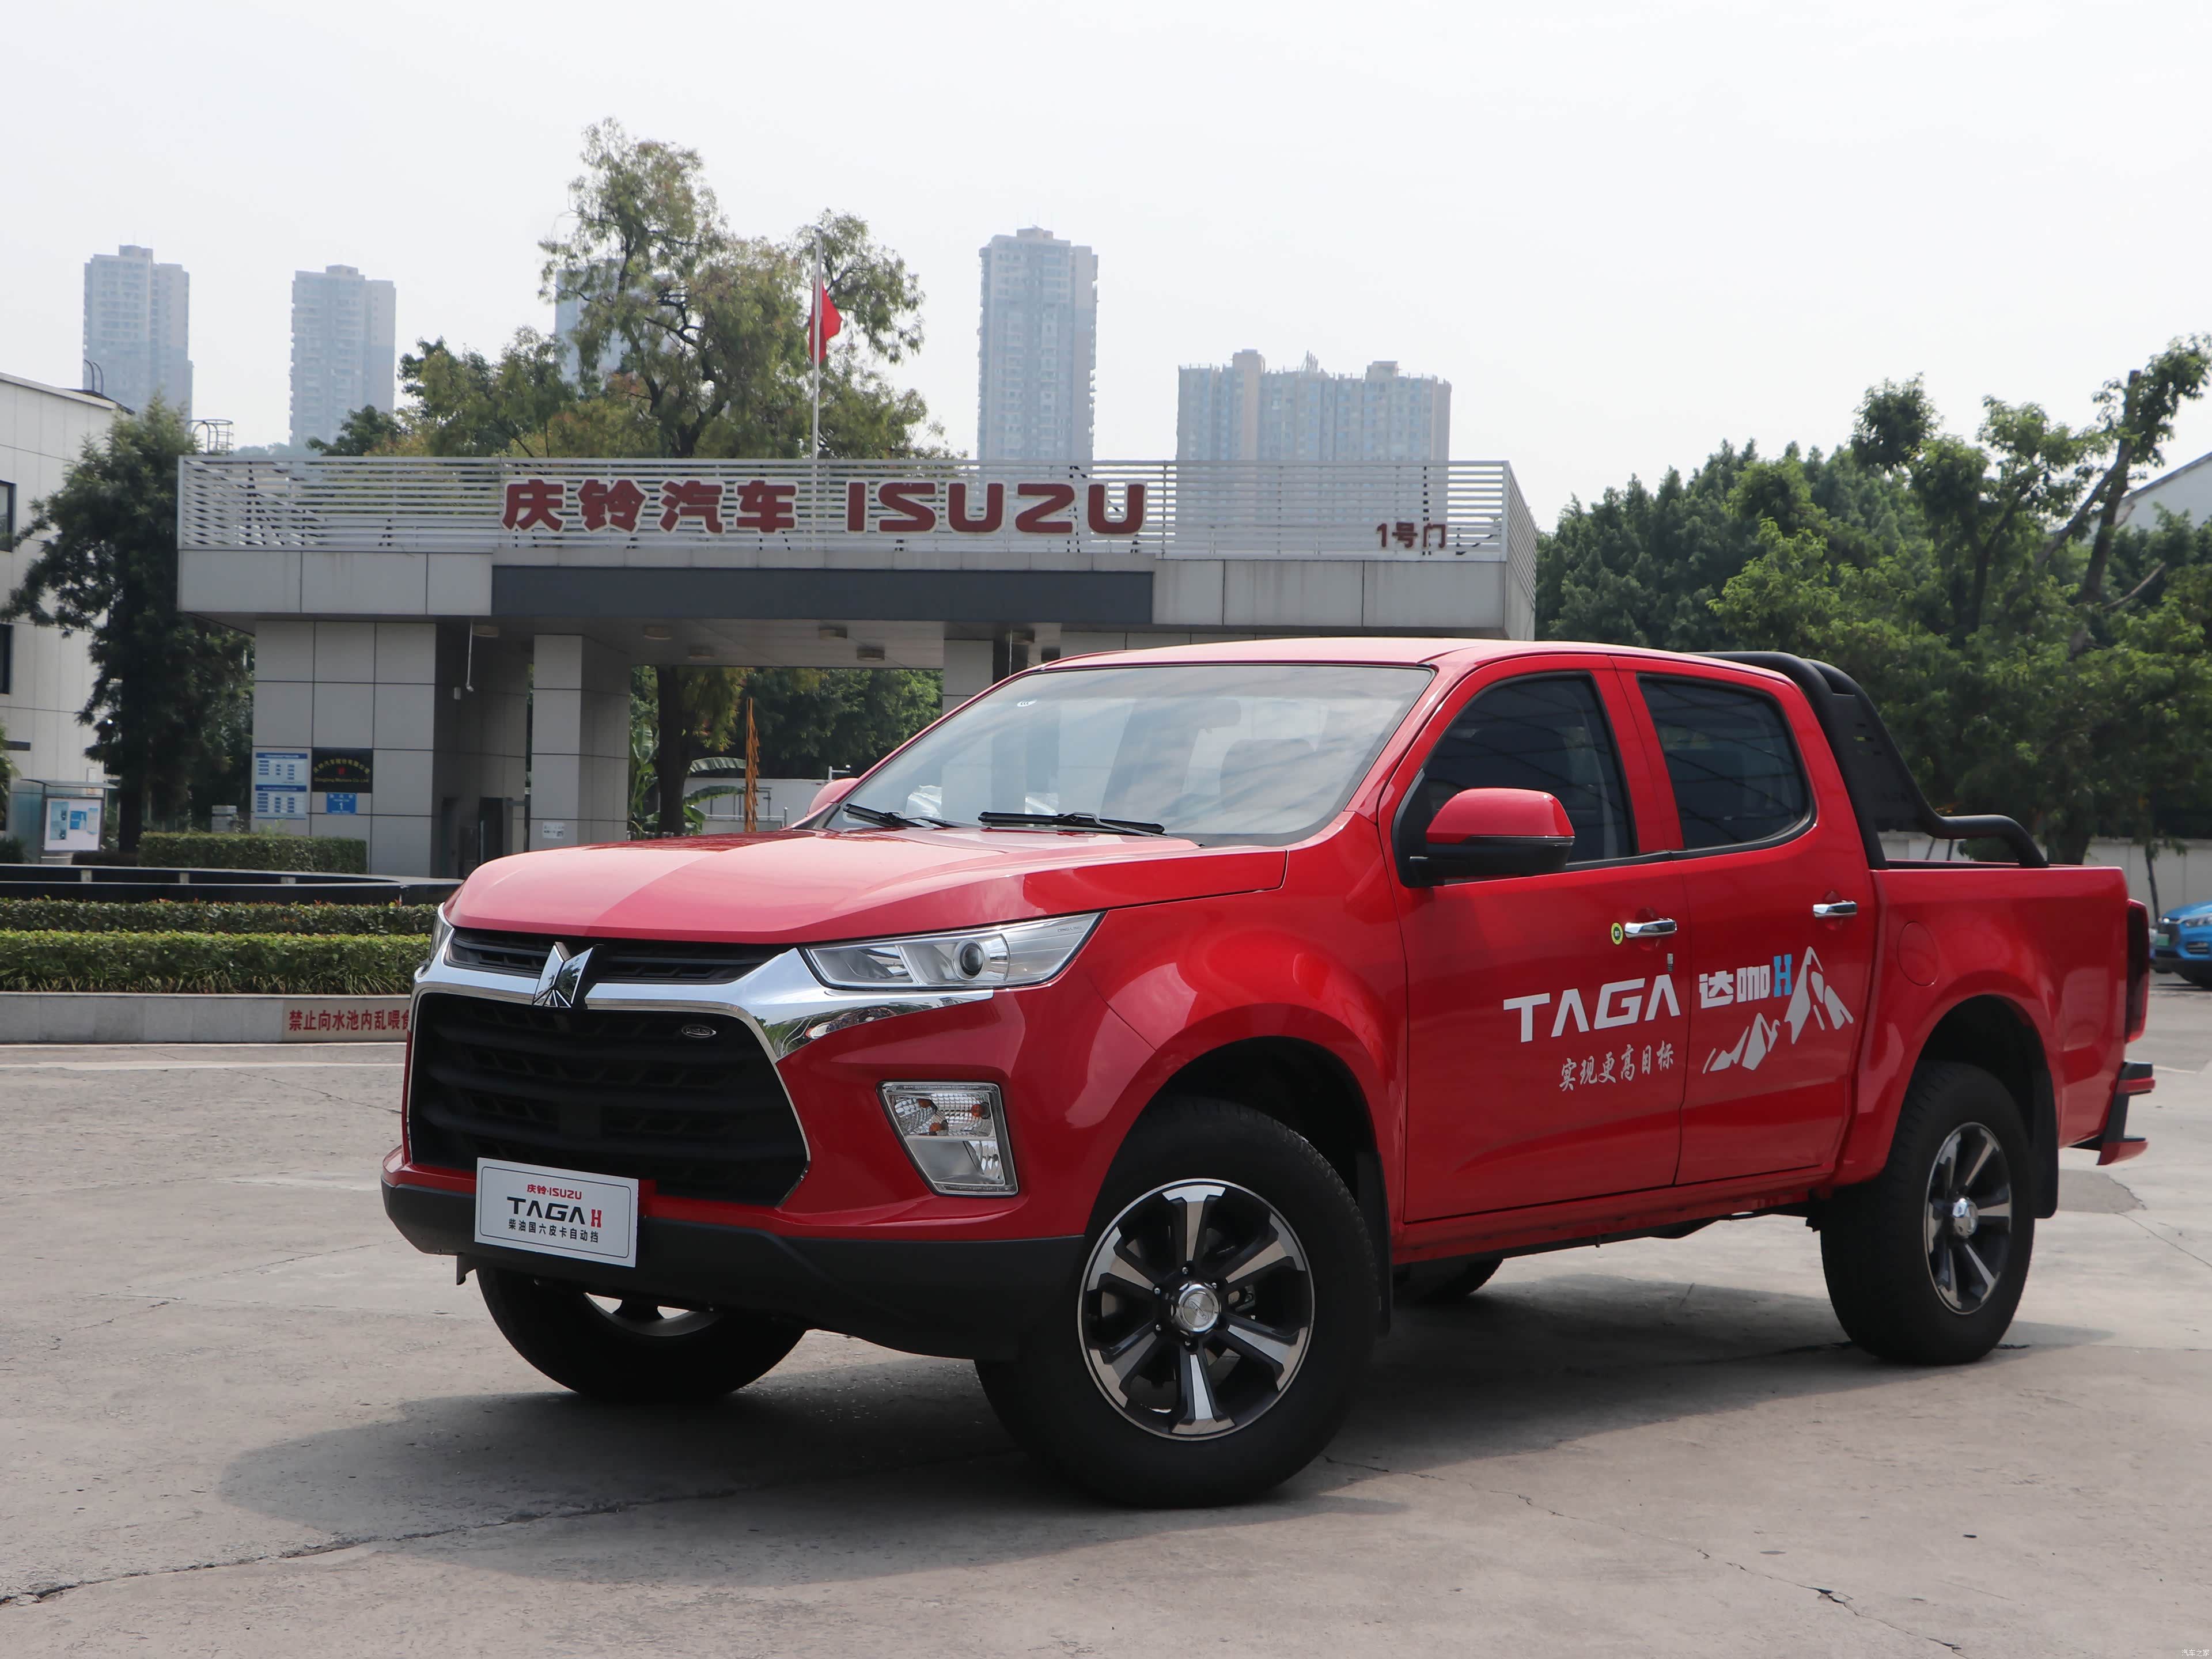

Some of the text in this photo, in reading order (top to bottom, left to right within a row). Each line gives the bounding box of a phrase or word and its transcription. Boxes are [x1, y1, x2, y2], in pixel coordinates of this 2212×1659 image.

[503, 478, 1145, 533] 庆铃汽车 ISUZU
[1377, 522, 1446, 548] 1号门
[1503, 974, 1681, 1043] TAGA
[1559, 1040, 1674, 1092] 实现更高目标
[507, 1196, 602, 1228] TAGA H
[508, 1218, 599, 1243] 柴油国六皮卡自动挡
